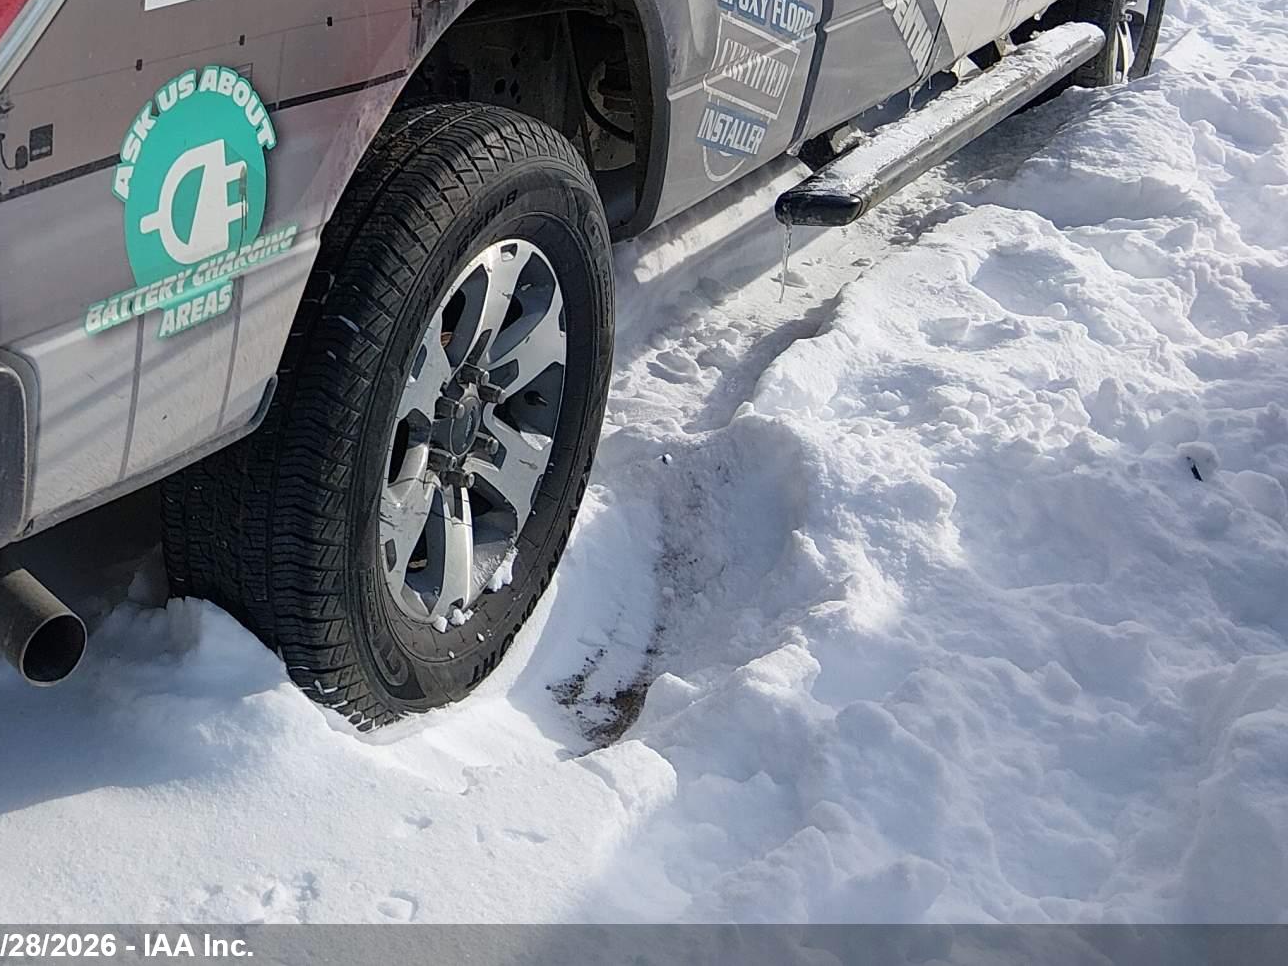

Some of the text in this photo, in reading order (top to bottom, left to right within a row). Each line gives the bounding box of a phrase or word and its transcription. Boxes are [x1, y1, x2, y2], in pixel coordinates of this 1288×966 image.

[719, 37, 789, 100] CERTIFIED
[112, 65, 278, 203] ASK US ABOUT
[697, 107, 766, 156] INSTALLER
[85, 224, 298, 334] BATTERY CHARGING
[159, 281, 234, 338] AREAS
